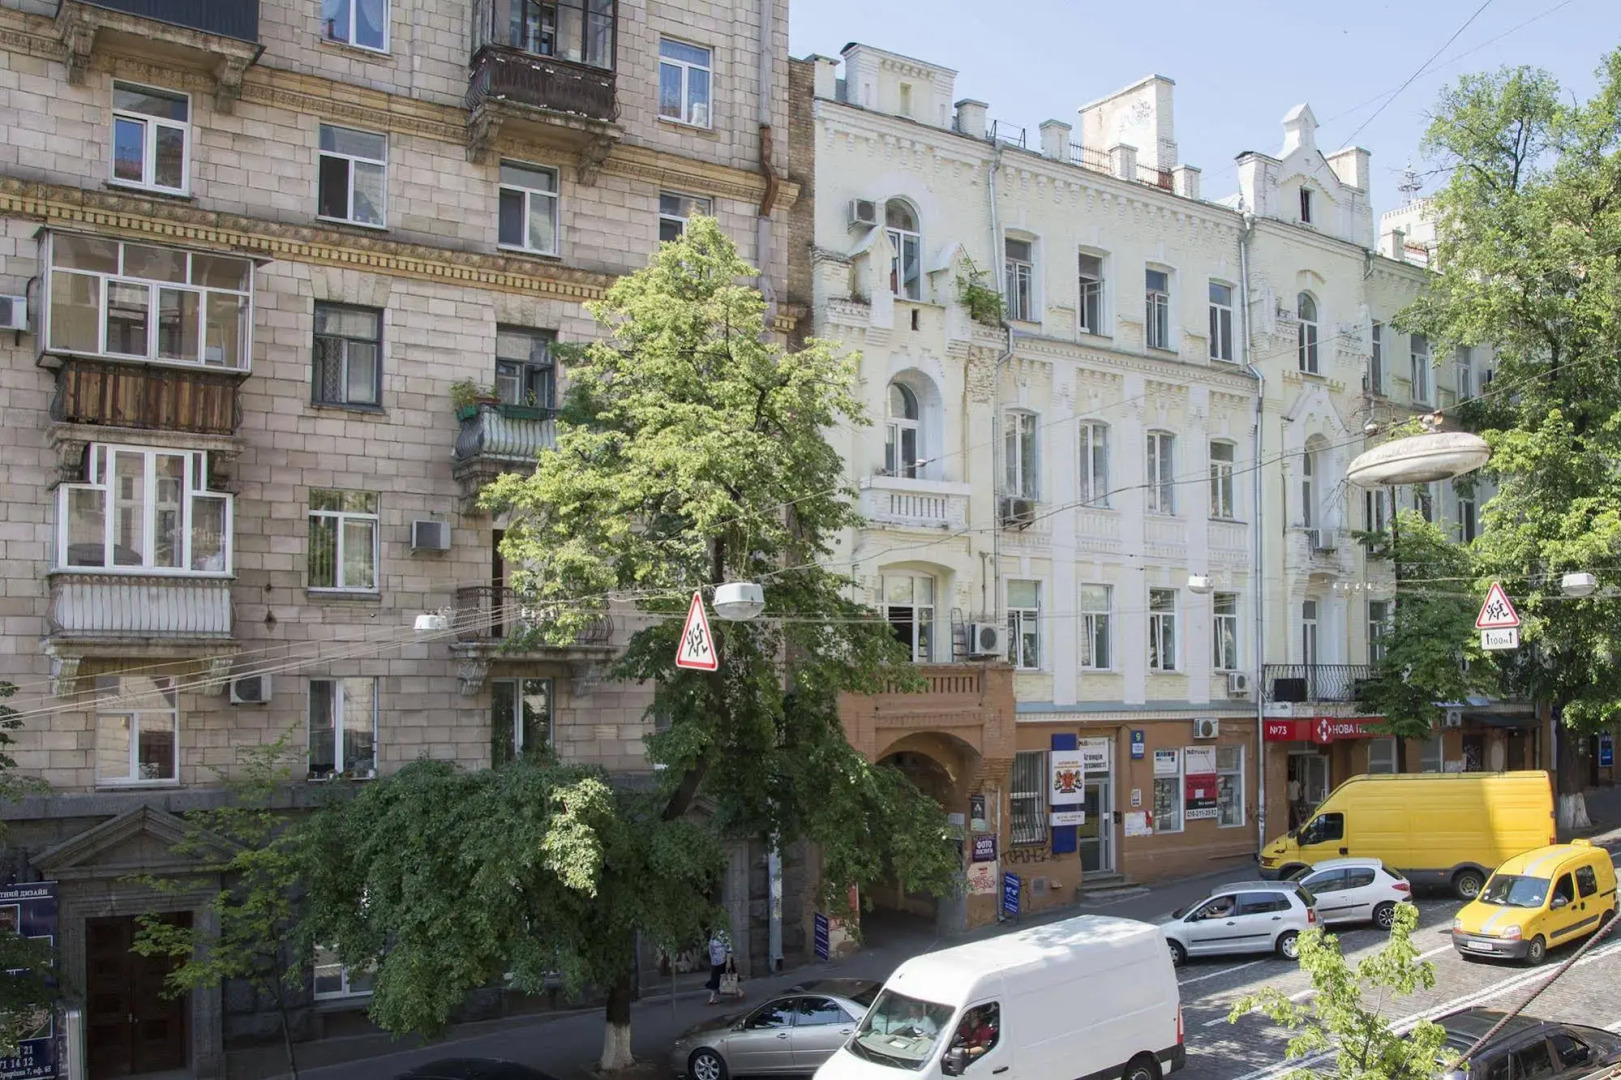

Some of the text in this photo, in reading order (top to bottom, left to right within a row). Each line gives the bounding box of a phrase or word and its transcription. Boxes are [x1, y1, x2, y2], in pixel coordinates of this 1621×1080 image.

[1269, 725, 1287, 735] №73
[1332, 724, 1354, 734] НОВА
[1135, 732, 1142, 742] 9
[976, 840, 993, 849] ФОТО
[20, 889, 48, 897] ДИЗАЙН
[24, 1045, 33, 1055] 21
[23, 1057, 33, 1067] 12
